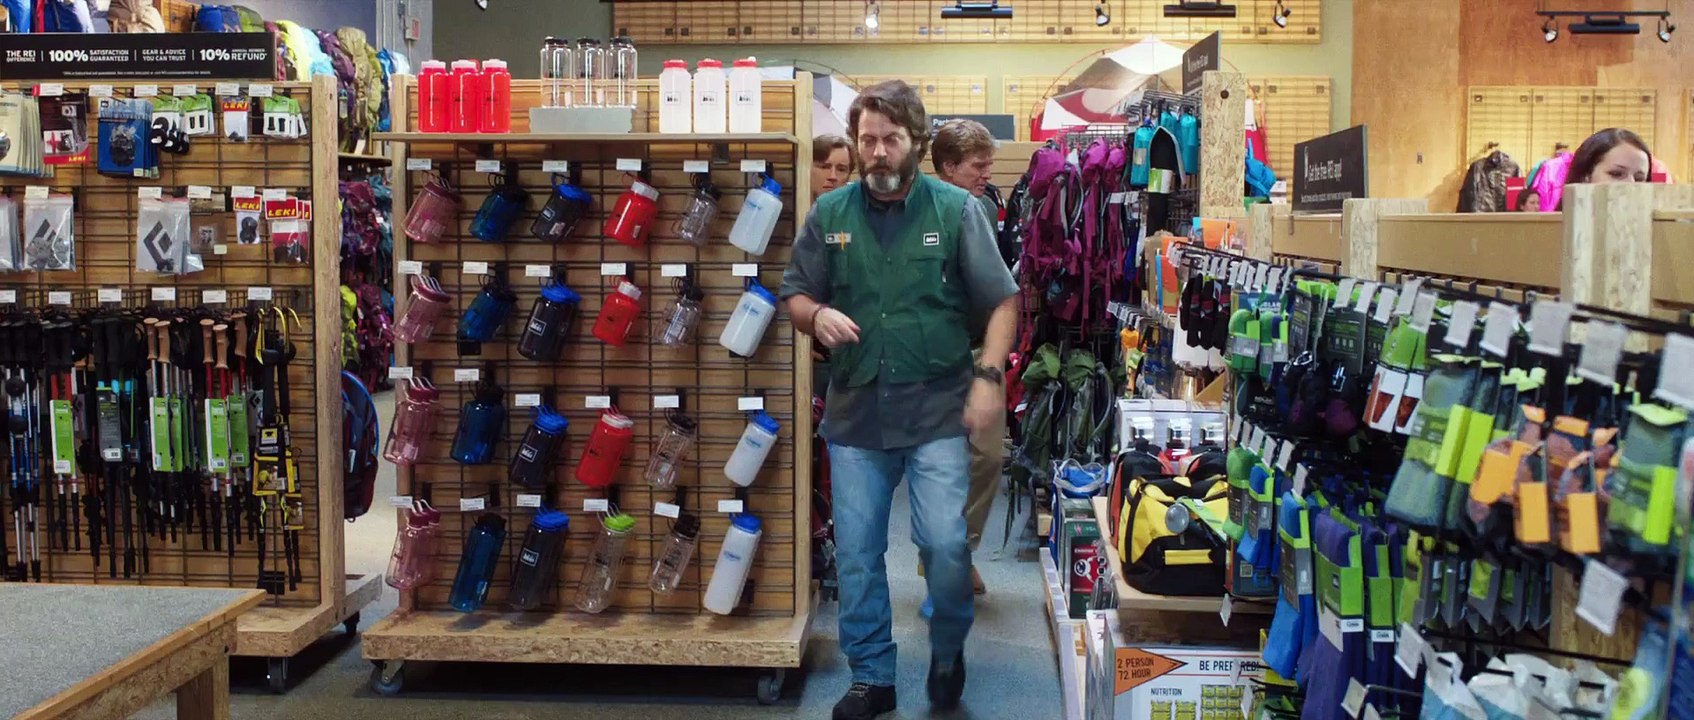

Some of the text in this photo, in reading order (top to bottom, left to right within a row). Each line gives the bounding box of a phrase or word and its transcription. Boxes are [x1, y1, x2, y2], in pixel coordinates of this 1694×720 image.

[49, 49, 89, 62] 100%
[200, 49, 230, 61] 10%
[235, 201, 259, 209] LEKI
[268, 208, 296, 217] LEKI
[1117, 658, 1154, 668] 2 PERSON
[1199, 660, 1210, 671] BE
[1118, 668, 1151, 680] 72 HOUR
[1151, 688, 1182, 696] NUTRITION
